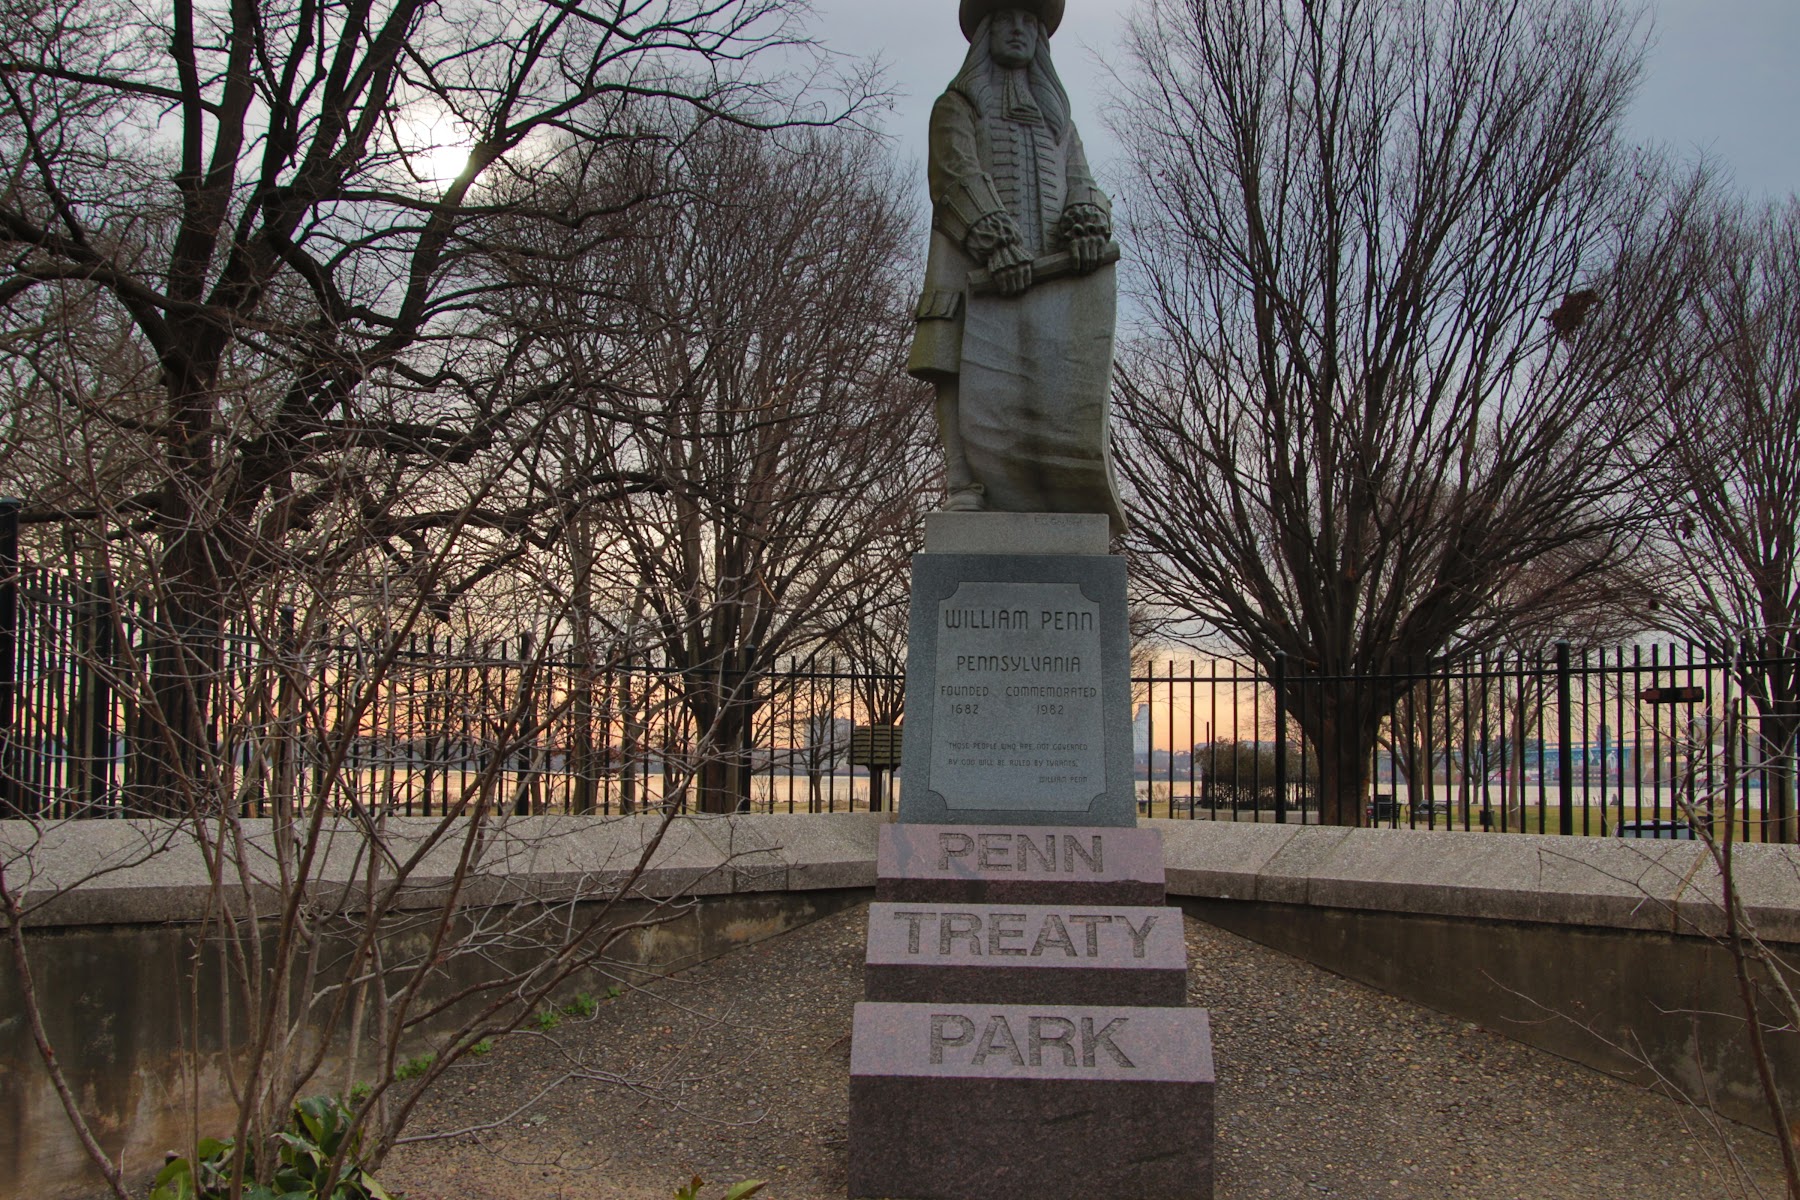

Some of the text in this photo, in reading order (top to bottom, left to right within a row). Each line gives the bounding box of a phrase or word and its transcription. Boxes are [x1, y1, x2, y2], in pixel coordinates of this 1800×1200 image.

[945, 609, 1093, 631] WILLIAM PENN
[957, 655, 1081, 673] PENNSYLVANIA
[941, 685, 1097, 698] FOUNDED COMMEMORATED
[951, 704, 1064, 716] 1682 1982
[973, 742, 997, 750] PEOPLE
[1000, 743, 1016, 751] WHO
[1036, 743, 1049, 751] NOT
[1052, 743, 1088, 751] GOVERNED
[948, 758, 958, 766] BY
[961, 758, 976, 766] GOD
[1009, 759, 1031, 767] RULED
[1034, 759, 1043, 767] BY
[1039, 776, 1088, 784] WILLIAM PENN
[937, 833, 1104, 873] PENN
[893, 911, 1160, 958] TREATY
[929, 1014, 1136, 1069] PARK
